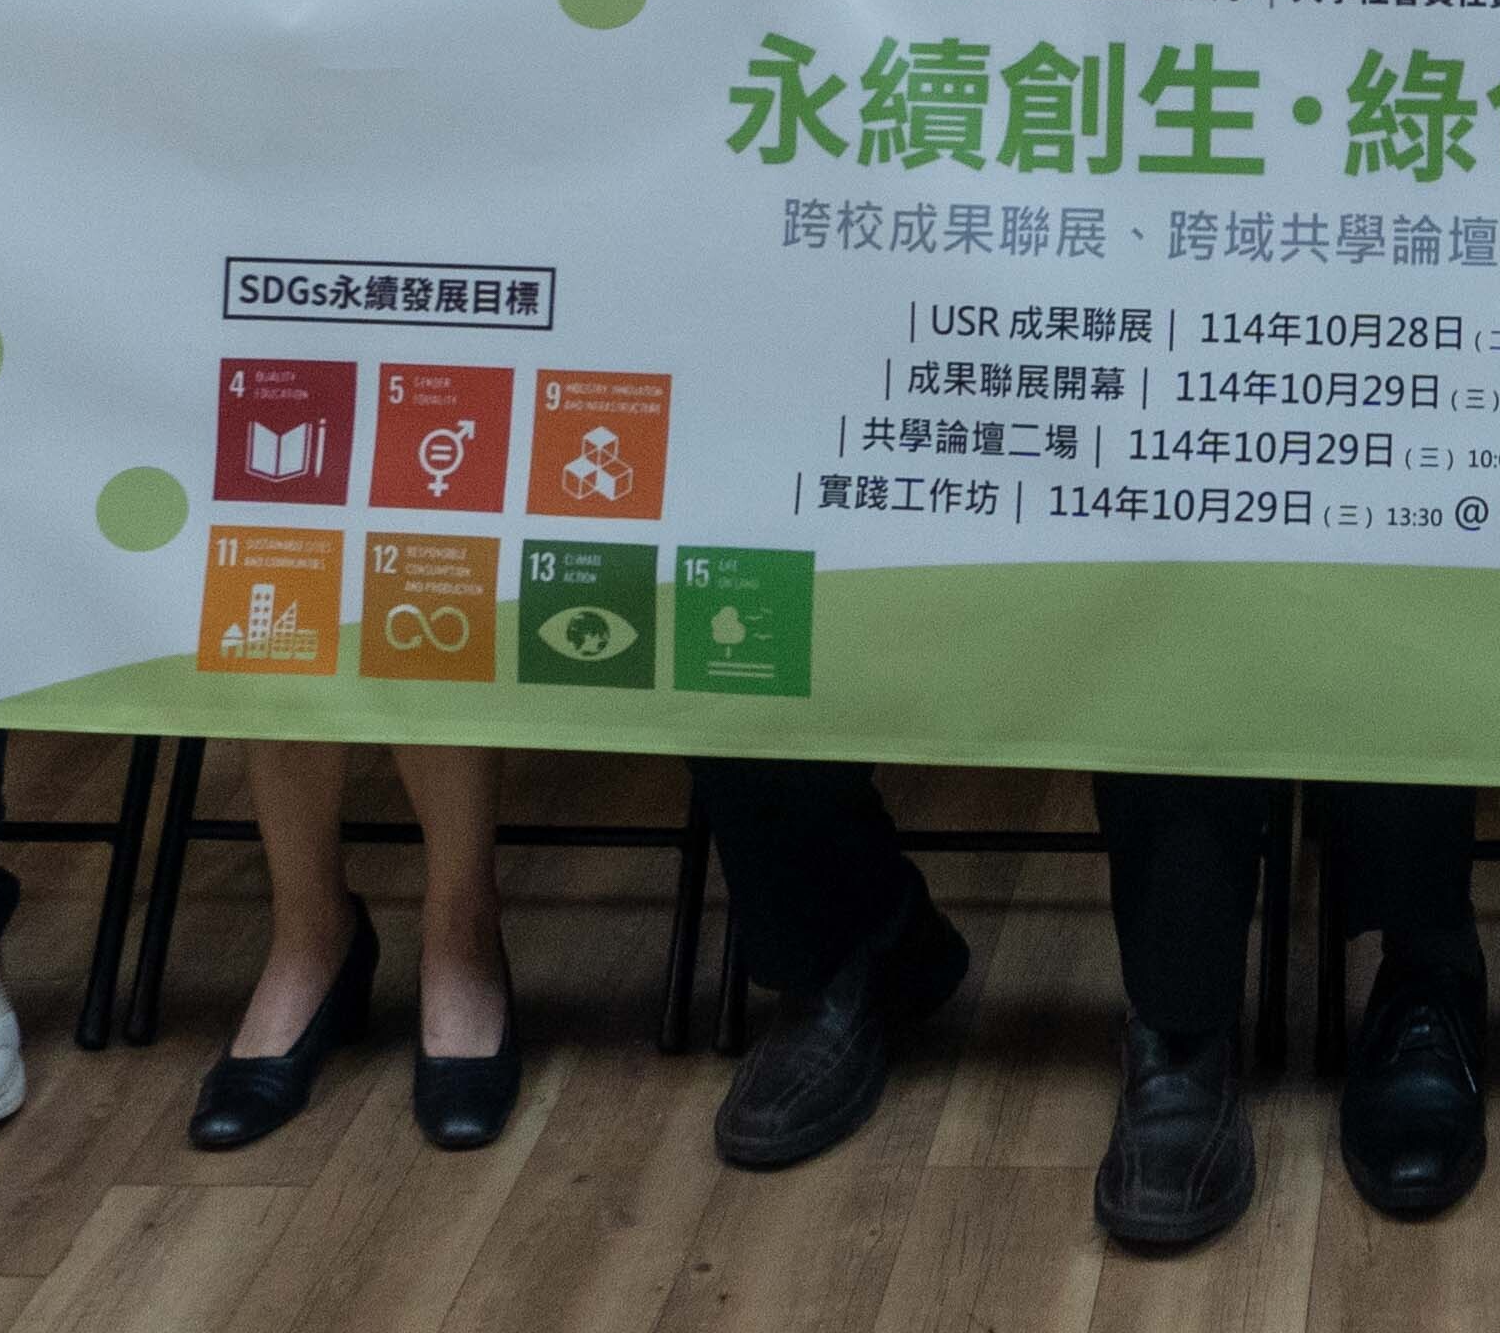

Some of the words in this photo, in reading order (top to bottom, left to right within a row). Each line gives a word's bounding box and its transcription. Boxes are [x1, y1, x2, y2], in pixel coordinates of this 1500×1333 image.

[239, 273, 540, 317] SDGs永續發展目標
[931, 306, 999, 337] USR
[1009, 305, 1153, 344] 成果聯展
[229, 371, 245, 398] 4
[389, 375, 404, 404] 5
[546, 382, 561, 411] 9
[908, 361, 1125, 402] 成果聯展開幕
[862, 416, 1079, 460] 共學論壇二場
[818, 474, 1000, 517] 實踐工作坊
[1387, 508, 1443, 527] 13:30
[1455, 495, 1489, 531] @
[216, 538, 238, 567] 11
[373, 545, 399, 574] 12
[529, 551, 556, 582] 13
[684, 559, 709, 588] 15
